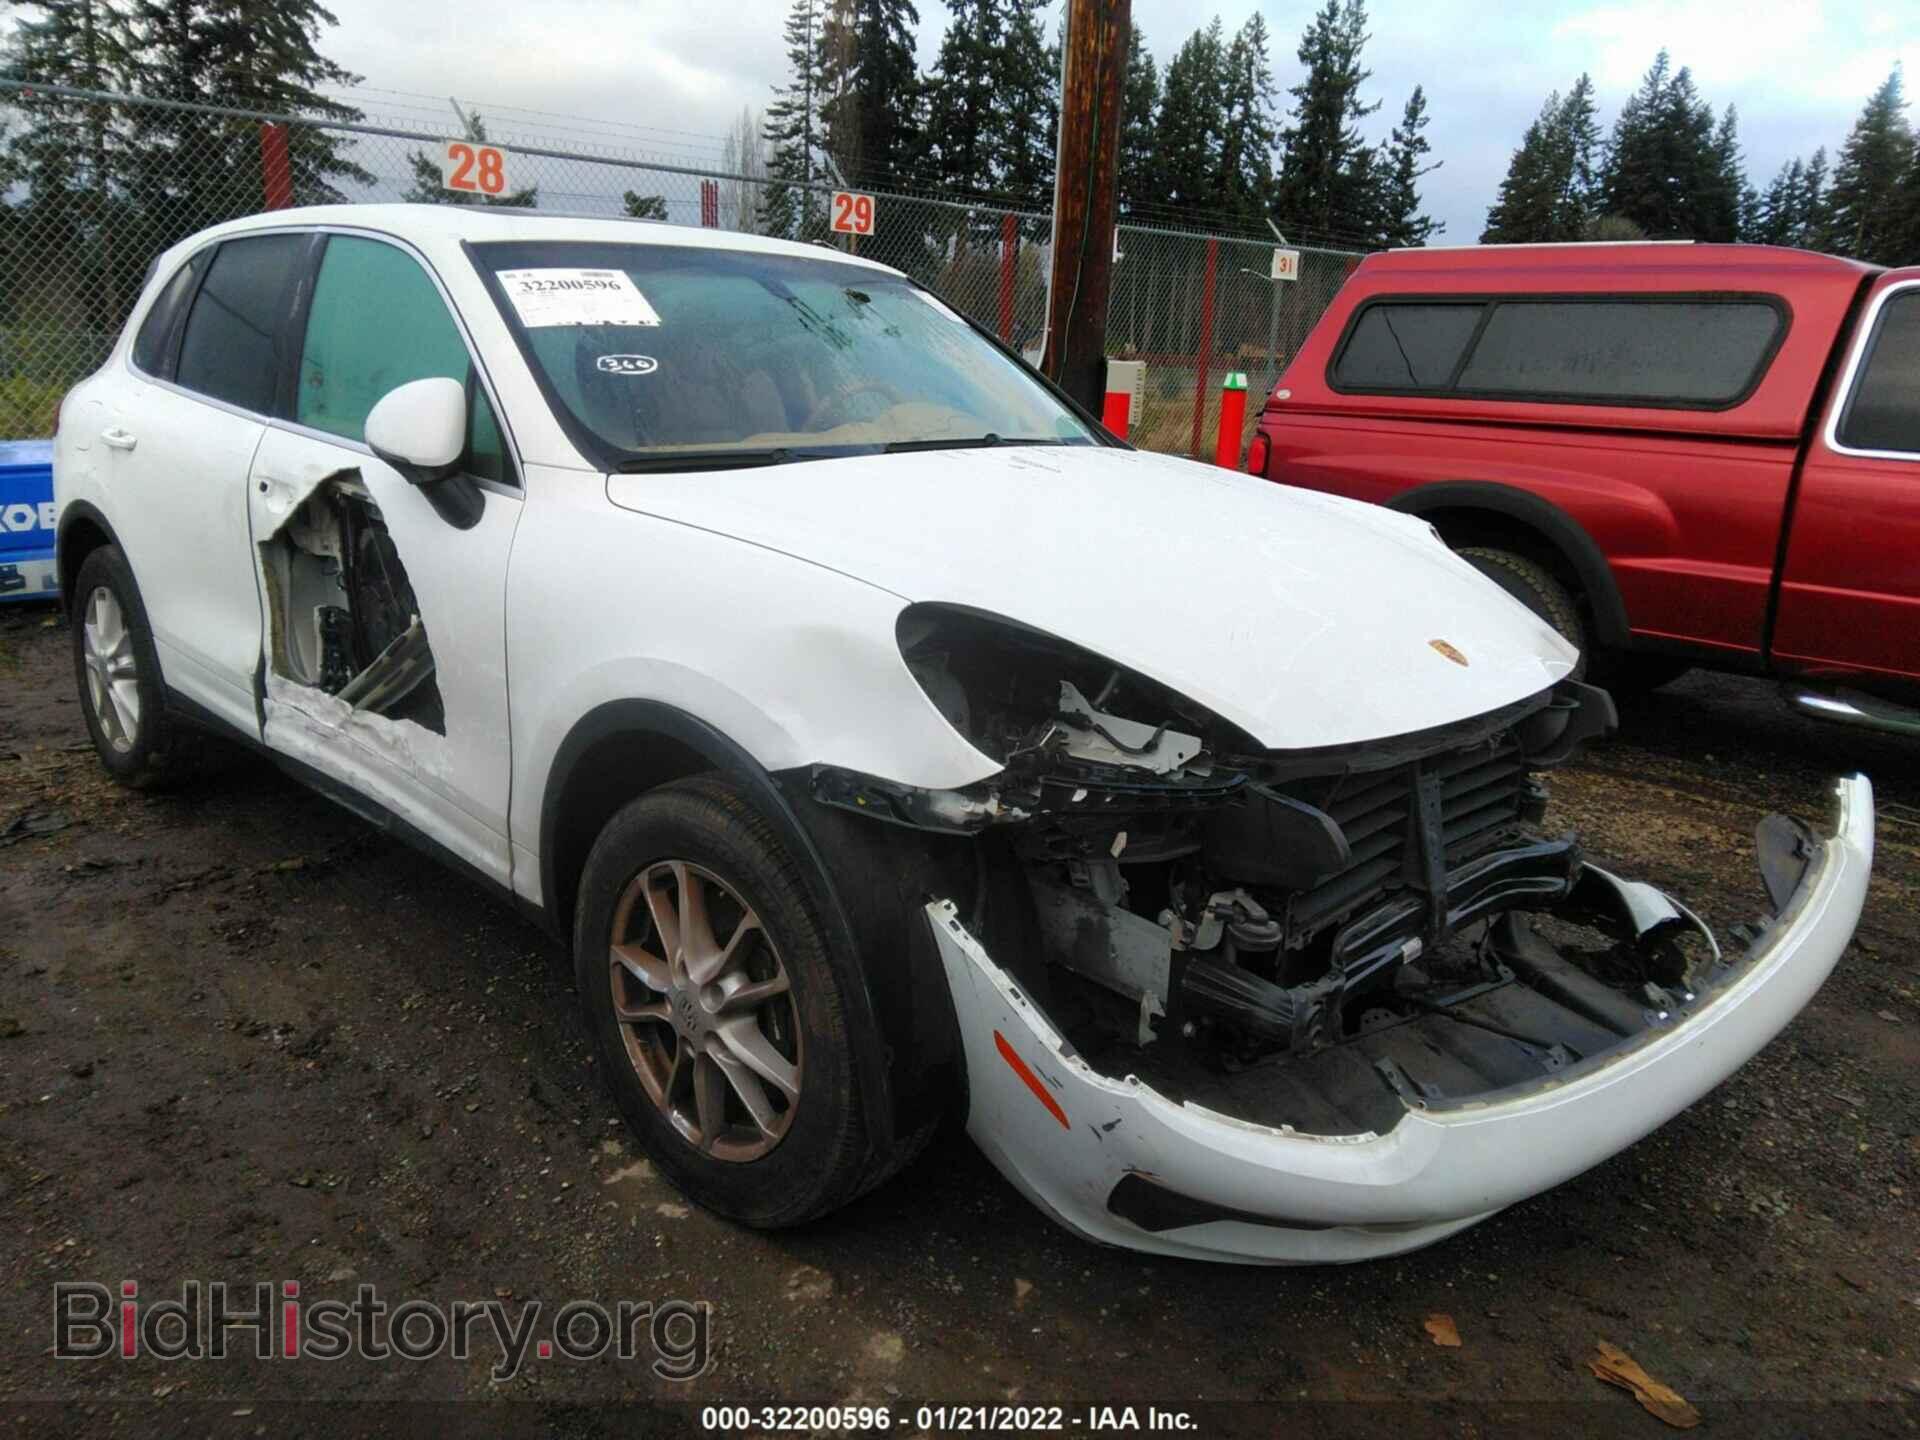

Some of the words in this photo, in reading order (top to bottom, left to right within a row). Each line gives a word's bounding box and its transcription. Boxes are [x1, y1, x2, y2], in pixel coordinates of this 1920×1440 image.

[448, 143, 505, 194] 28
[834, 193, 872, 233] 29
[1279, 256, 1293, 273] 31
[519, 279, 622, 293] 32200596
